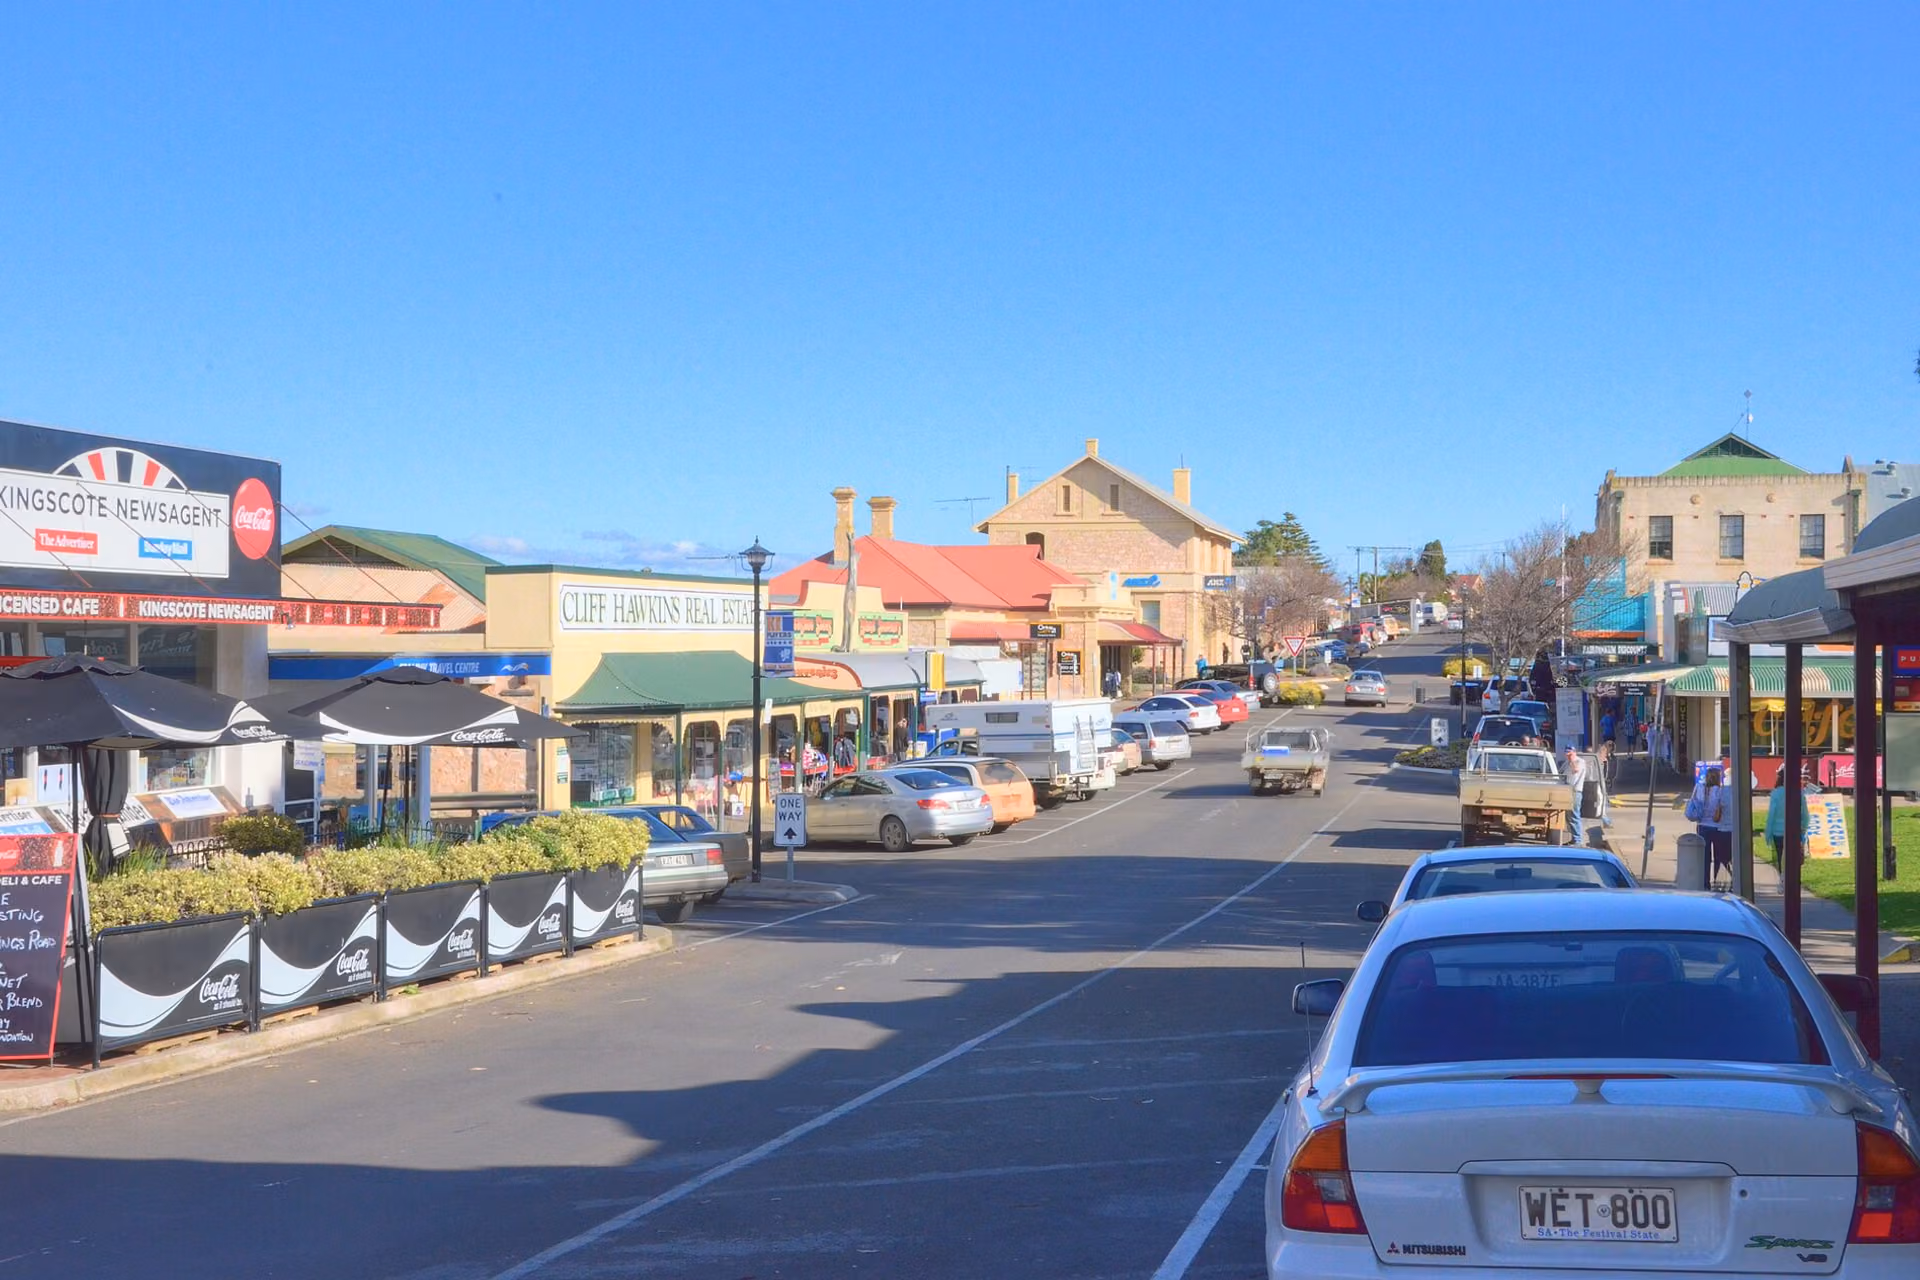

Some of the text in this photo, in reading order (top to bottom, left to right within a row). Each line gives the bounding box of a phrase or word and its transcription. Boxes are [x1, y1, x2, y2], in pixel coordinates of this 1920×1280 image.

[0, 486, 221, 528] KINGSCOTE NEWSAGENT
[235, 504, 272, 531] Coca-Cola
[39, 533, 94, 549] The Advertiser
[0, 595, 99, 615] CENSED CAFE
[138, 600, 275, 620] KINGSCOTE NEWSAGENT
[563, 591, 607, 623] CLIFF
[613, 593, 680, 624] HAWKINS
[686, 597, 717, 624] REAL
[722, 599, 763, 624] ESTAT
[429, 662, 454, 674] TRAVEL
[455, 662, 480, 673] CENTRE
[450, 728, 506, 743] Coca-Cola
[780, 799, 801, 808] ONE
[779, 812, 802, 821] WAY
[0, 875, 63, 886] ELI & CAFE
[28, 929, 57, 950] ROAD
[336, 948, 370, 976] Coca-Cola
[199, 973, 240, 1003] Coca-Cola
[6, 991, 43, 1010] BLEND
[1525, 1191, 1671, 1229] WET 800
[1583, 1228, 1627, 1239] Festival
[1630, 1230, 1660, 1240] State
[1402, 1243, 1467, 1256] MITSUBISHI
